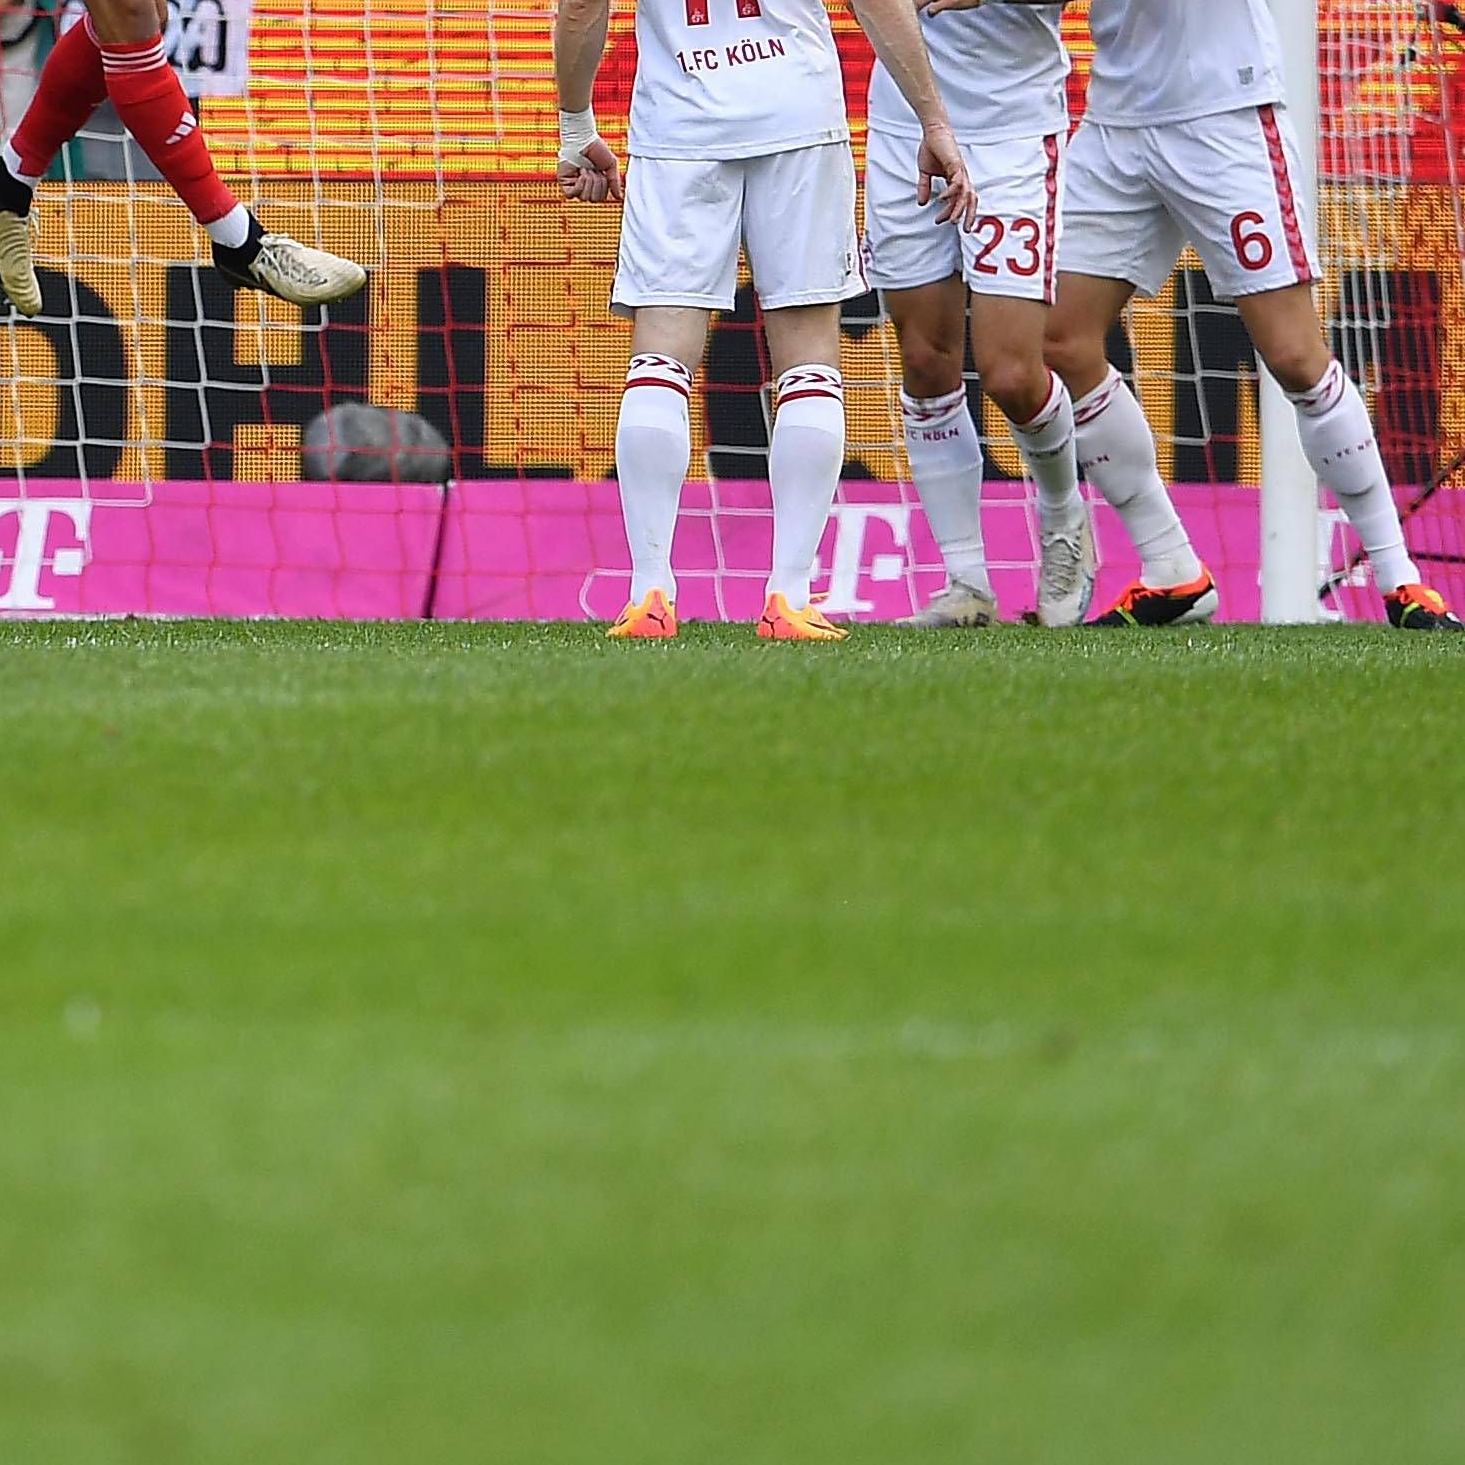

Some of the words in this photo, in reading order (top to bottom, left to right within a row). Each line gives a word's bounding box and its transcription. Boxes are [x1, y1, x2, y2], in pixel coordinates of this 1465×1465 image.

[726, 38, 786, 67] KÖLN
[972, 216, 1041, 276] 23
[1230, 211, 1273, 271] 6
